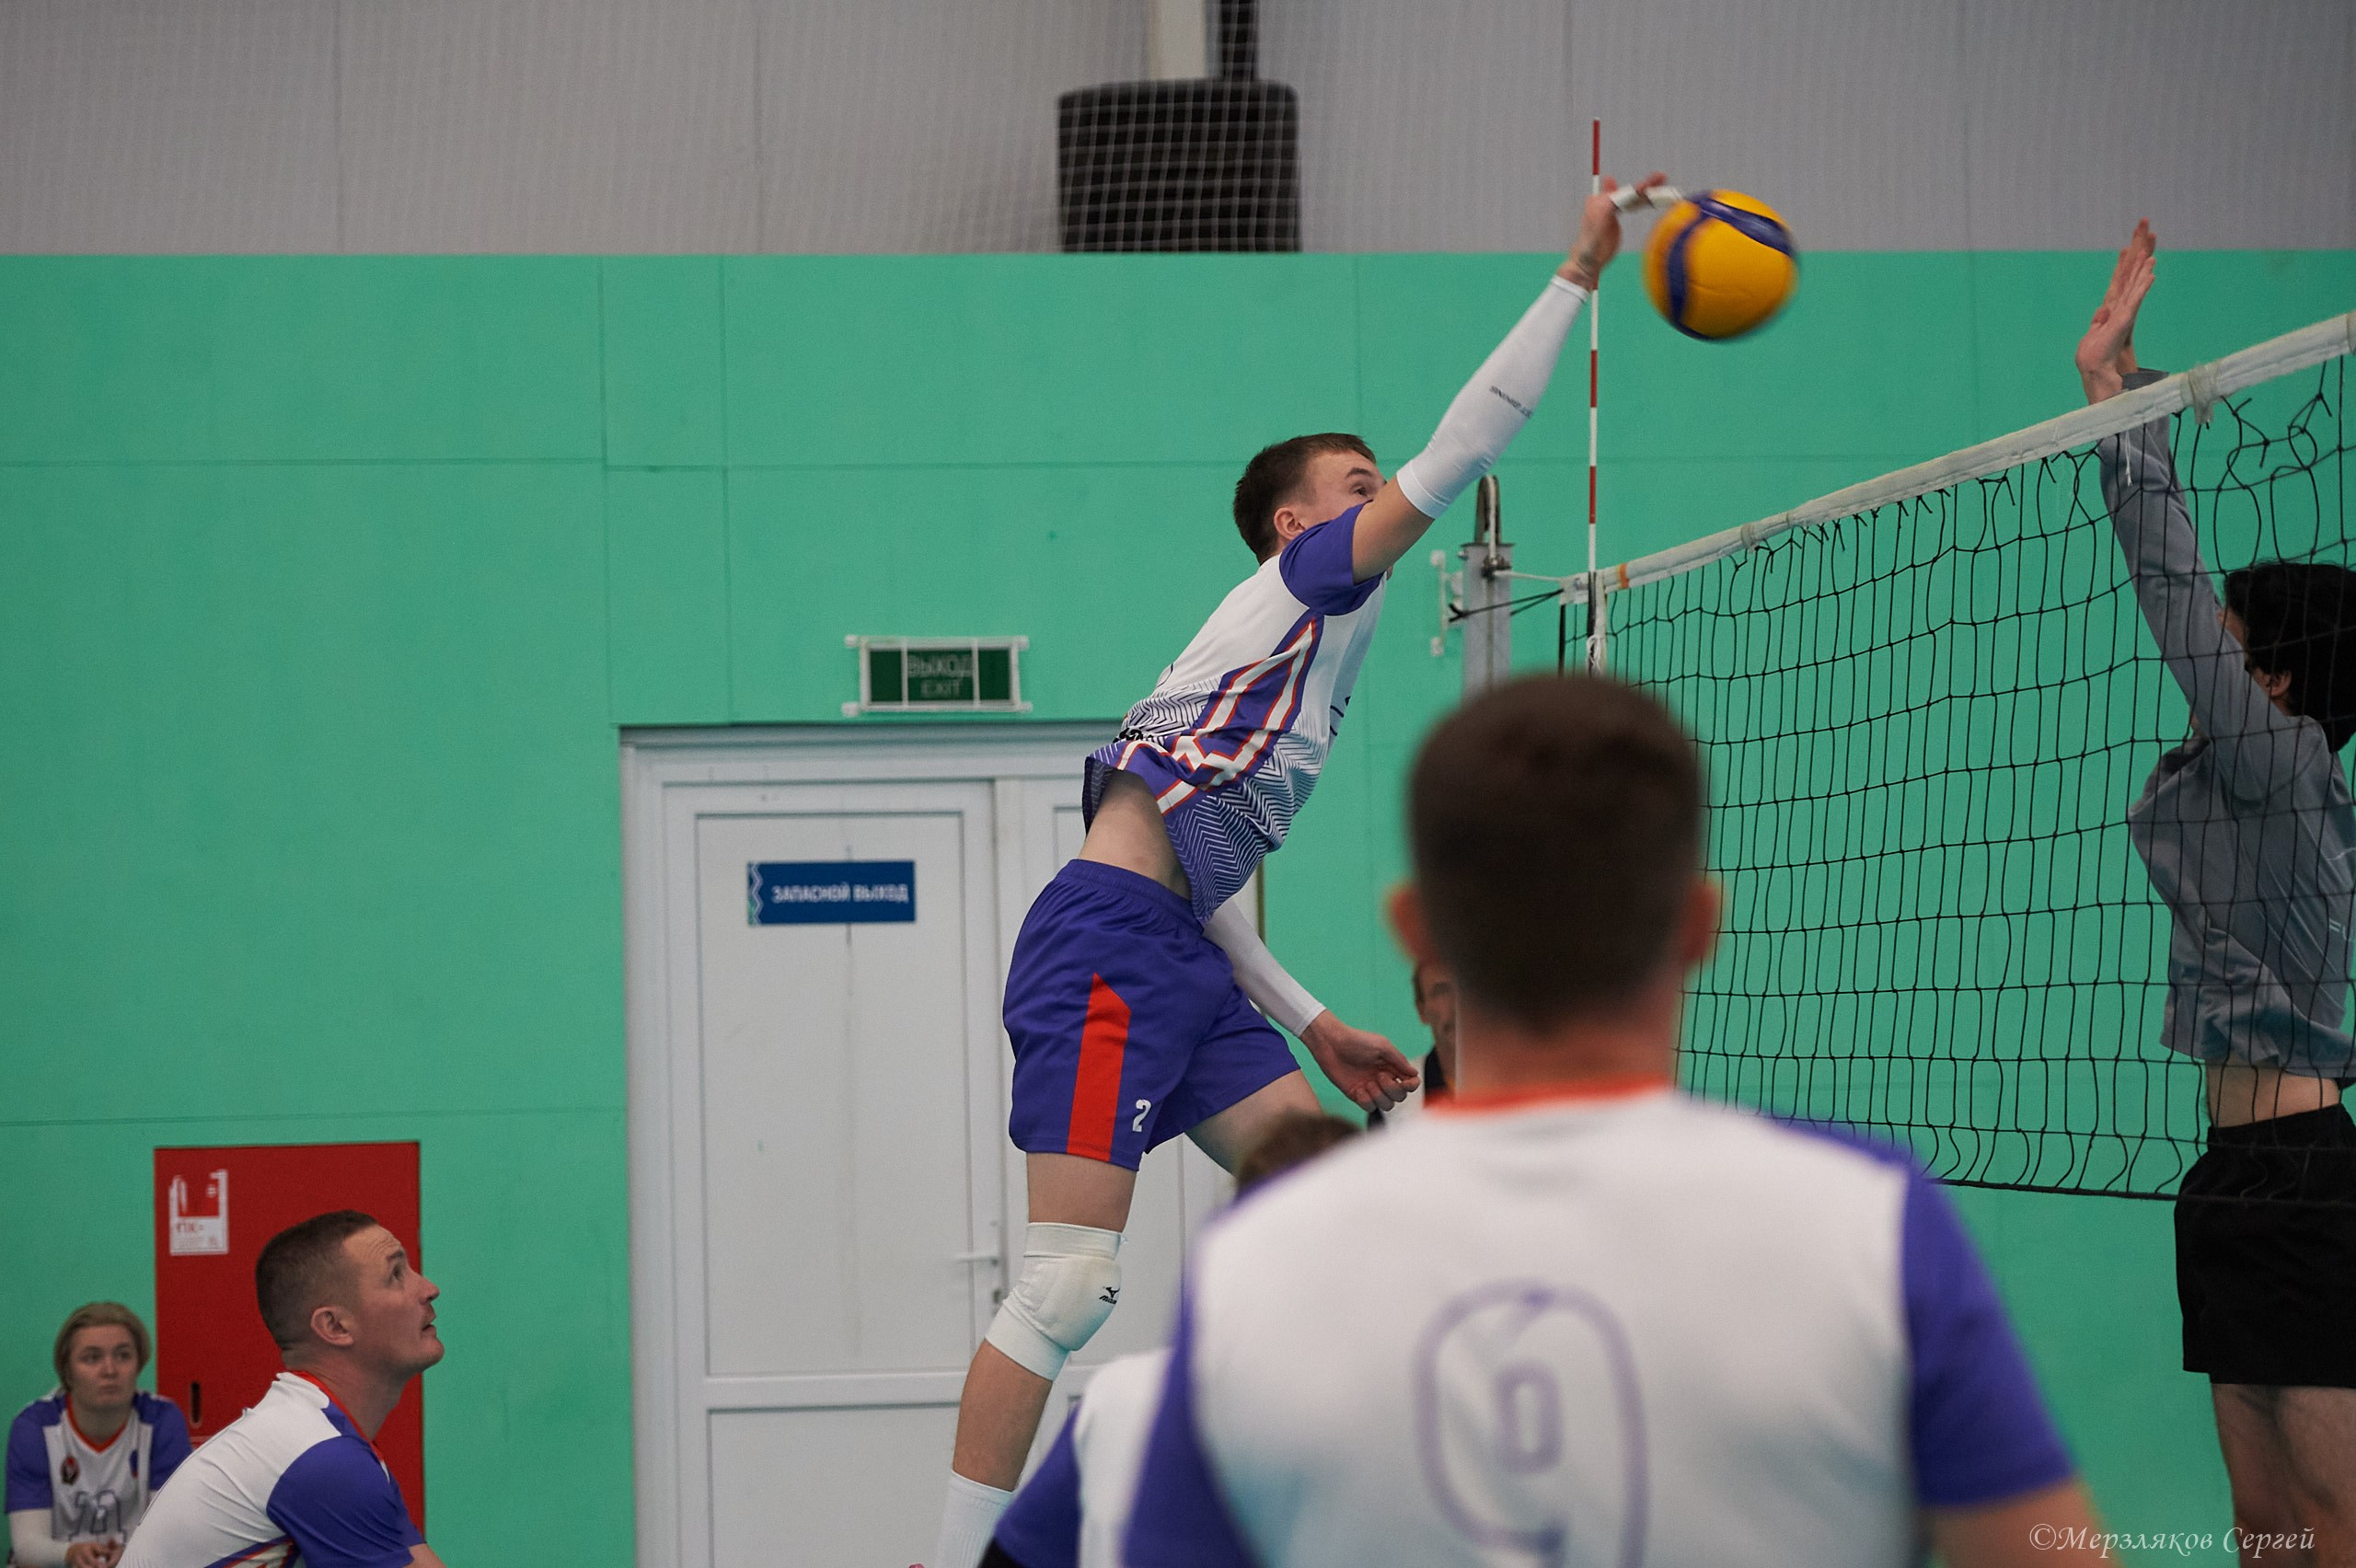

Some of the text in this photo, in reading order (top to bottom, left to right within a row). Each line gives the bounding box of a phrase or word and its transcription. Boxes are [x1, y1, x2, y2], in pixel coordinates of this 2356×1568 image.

[772, 882, 909, 904] ЗАПАСНОЙ ВЫХОД
[1132, 1099, 1151, 1132] 2
